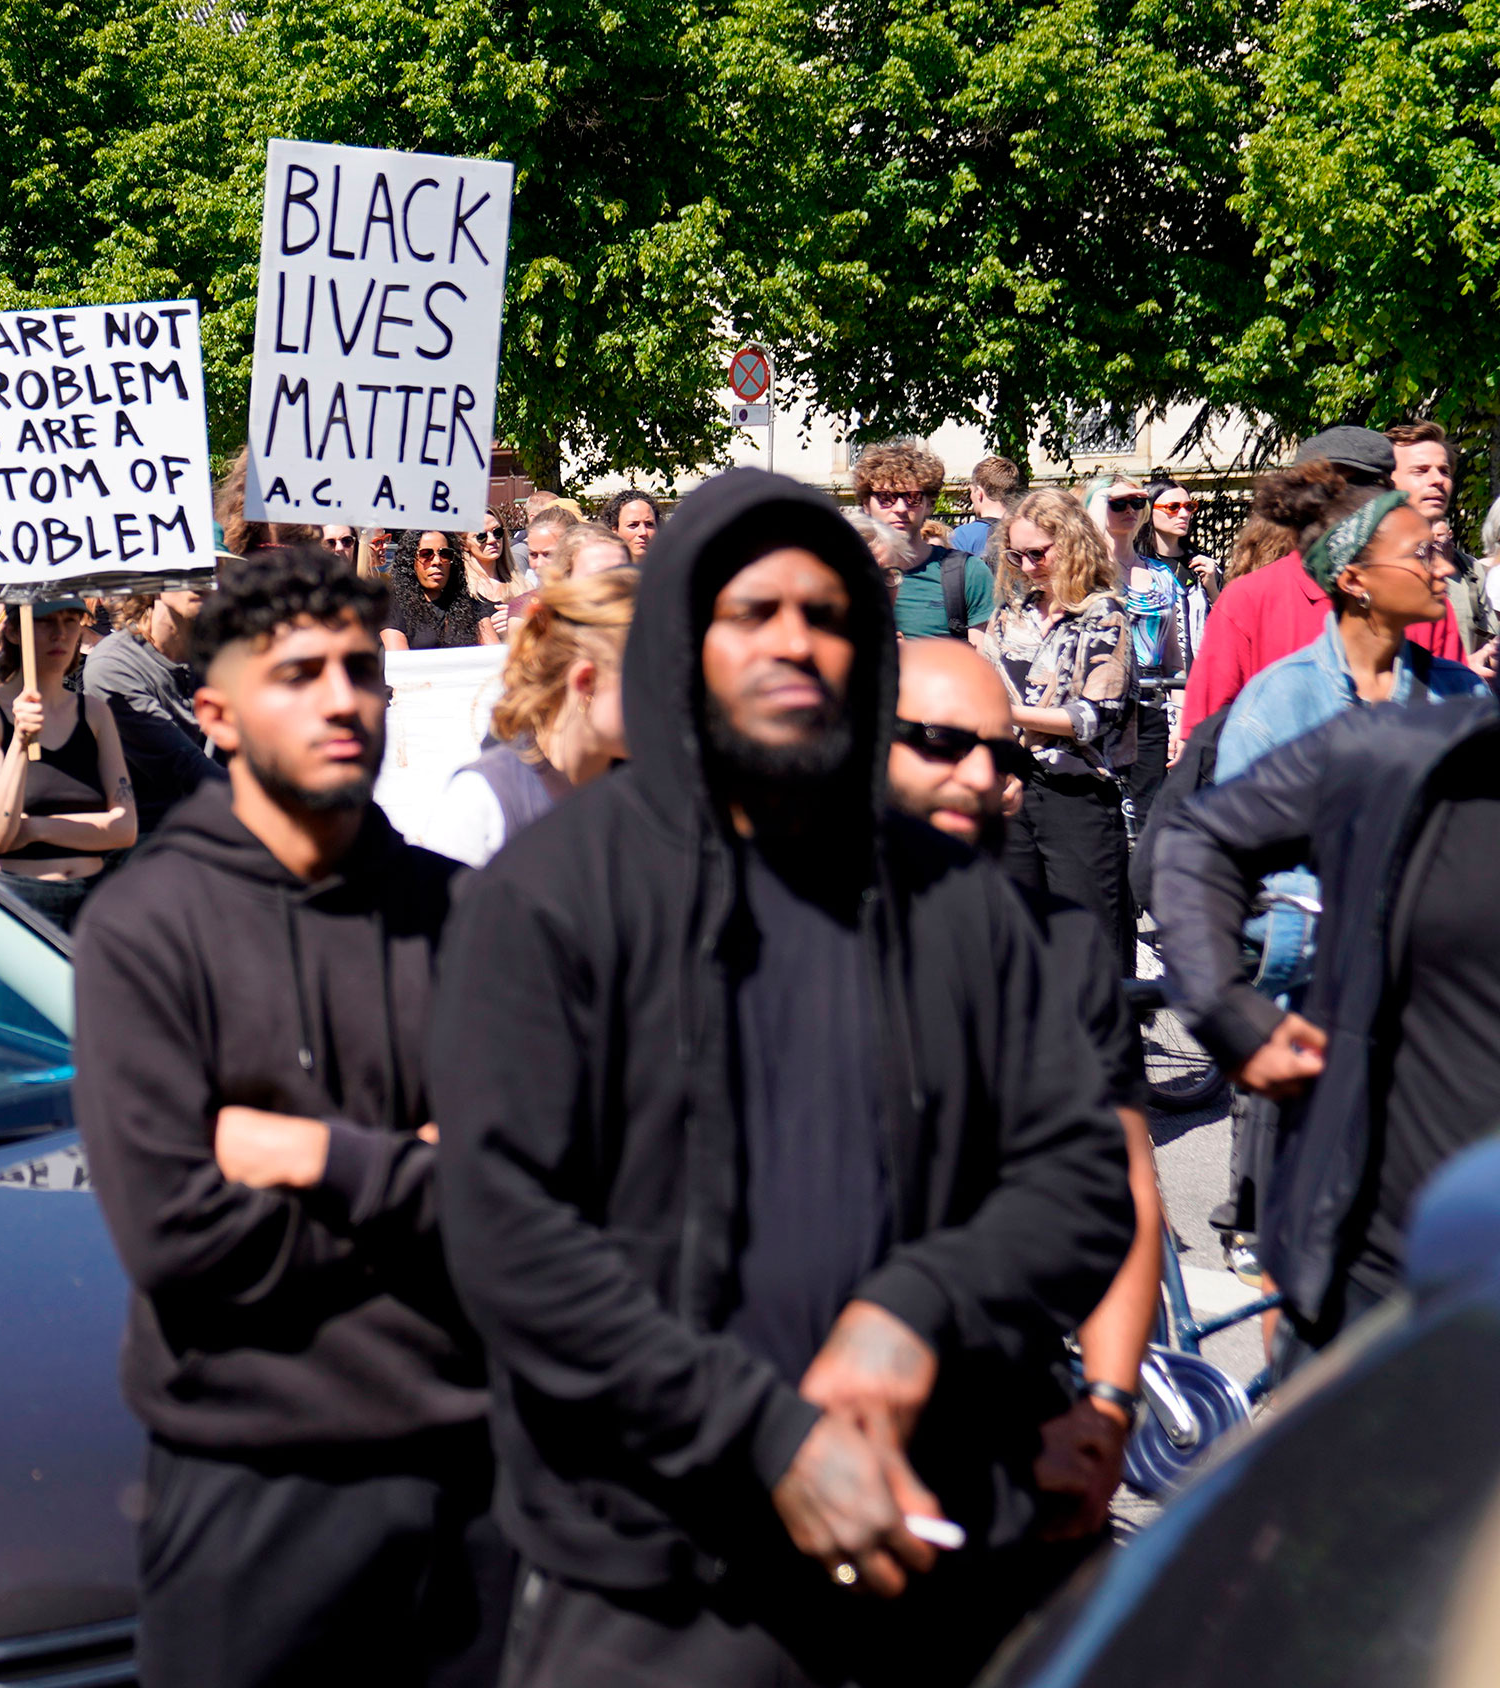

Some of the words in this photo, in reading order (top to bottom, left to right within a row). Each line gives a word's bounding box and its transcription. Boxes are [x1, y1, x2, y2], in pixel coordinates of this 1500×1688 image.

[281, 163, 491, 266] BLACK
[105, 309, 192, 349] NOT
[275, 271, 468, 361] LIVES
[17, 414, 97, 454] ARE
[115, 410, 144, 447] A
[264, 374, 485, 470] MATTER
[129, 455, 191, 495] OF
